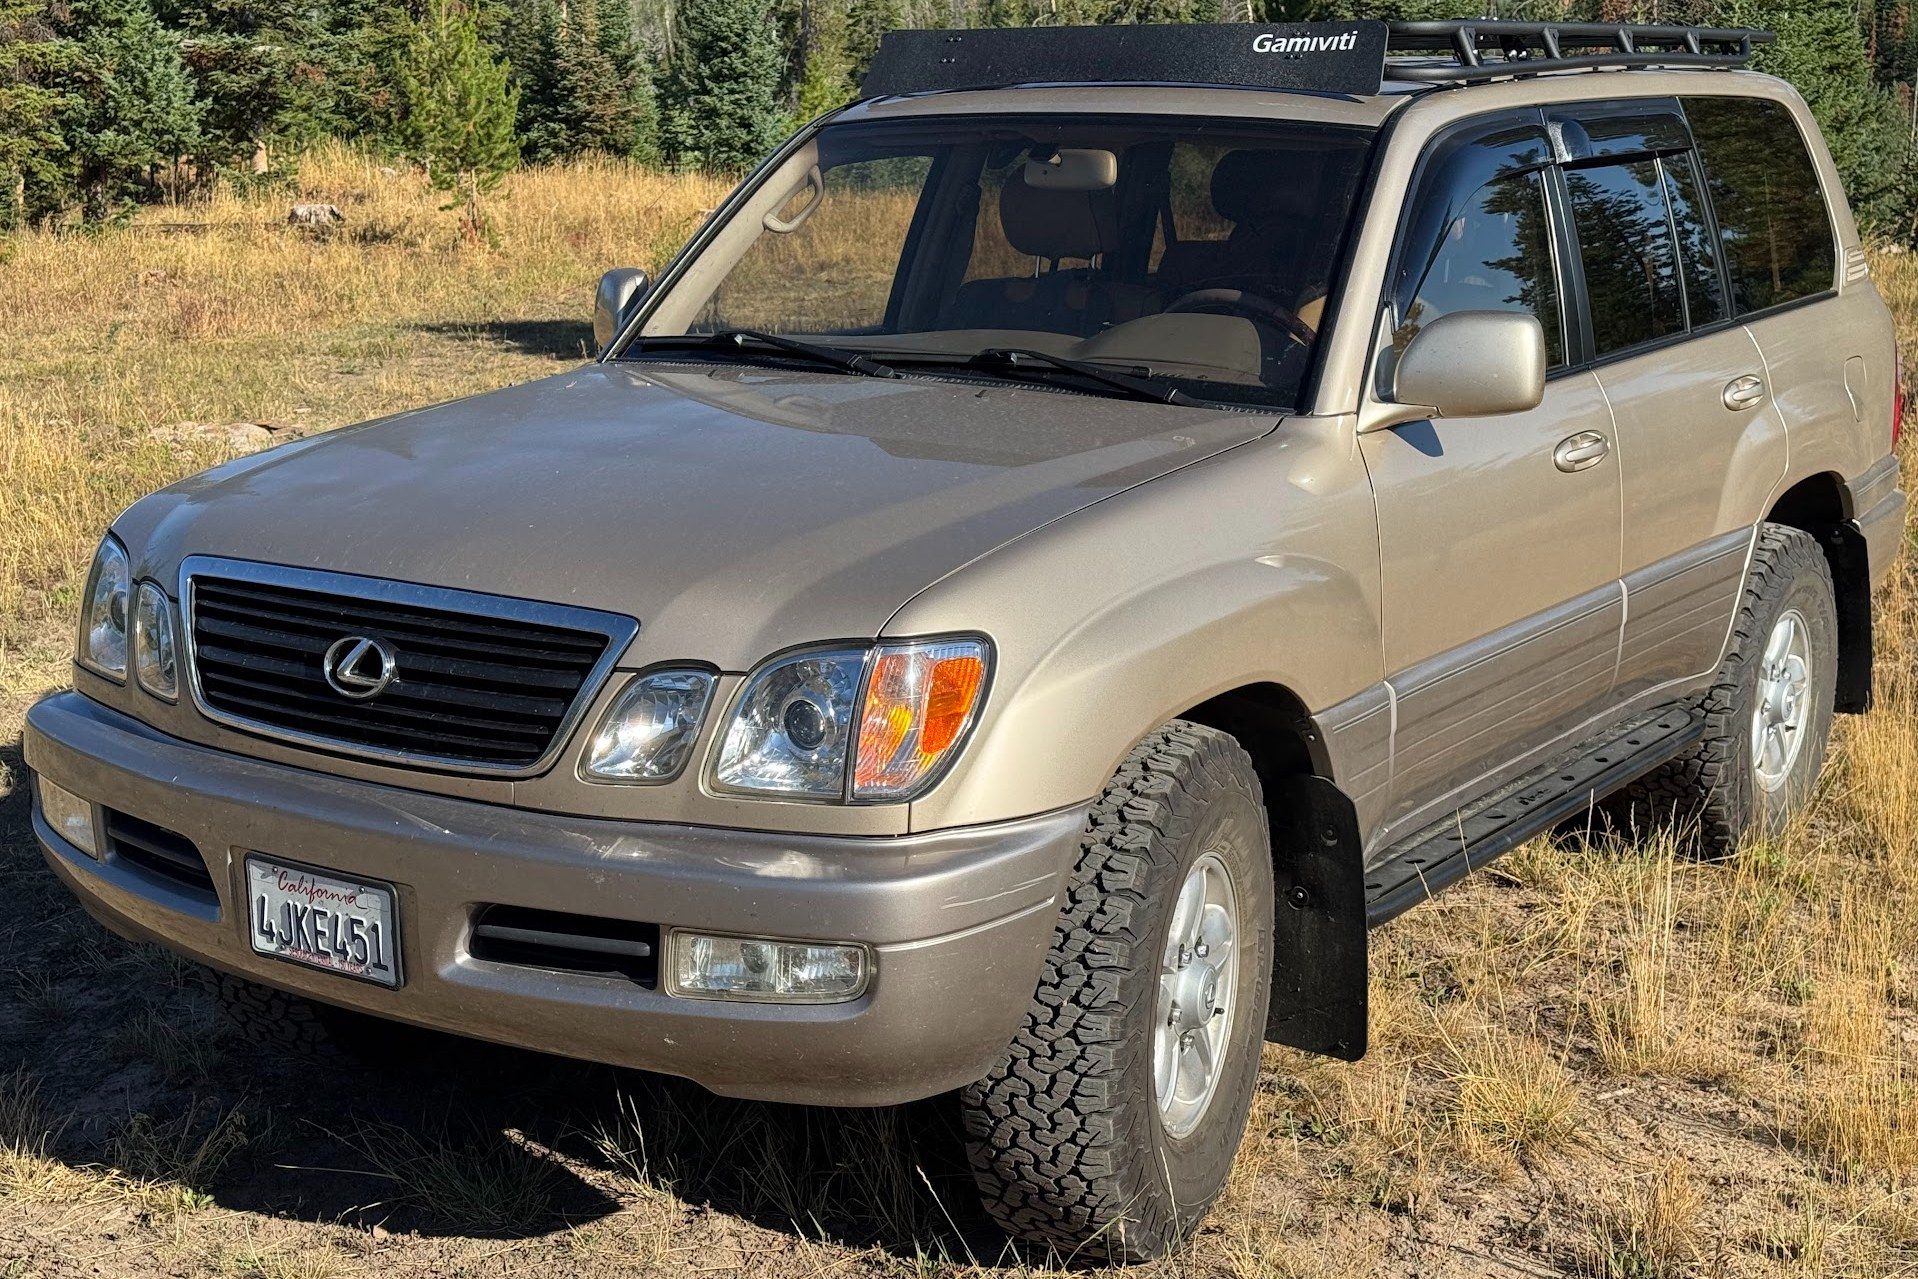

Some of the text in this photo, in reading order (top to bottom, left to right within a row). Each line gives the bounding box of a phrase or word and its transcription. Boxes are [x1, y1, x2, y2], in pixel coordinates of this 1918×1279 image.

[1252, 30, 1358, 53] Gamiviti
[277, 870, 367, 909] California
[258, 893, 389, 972] 4JKE451
